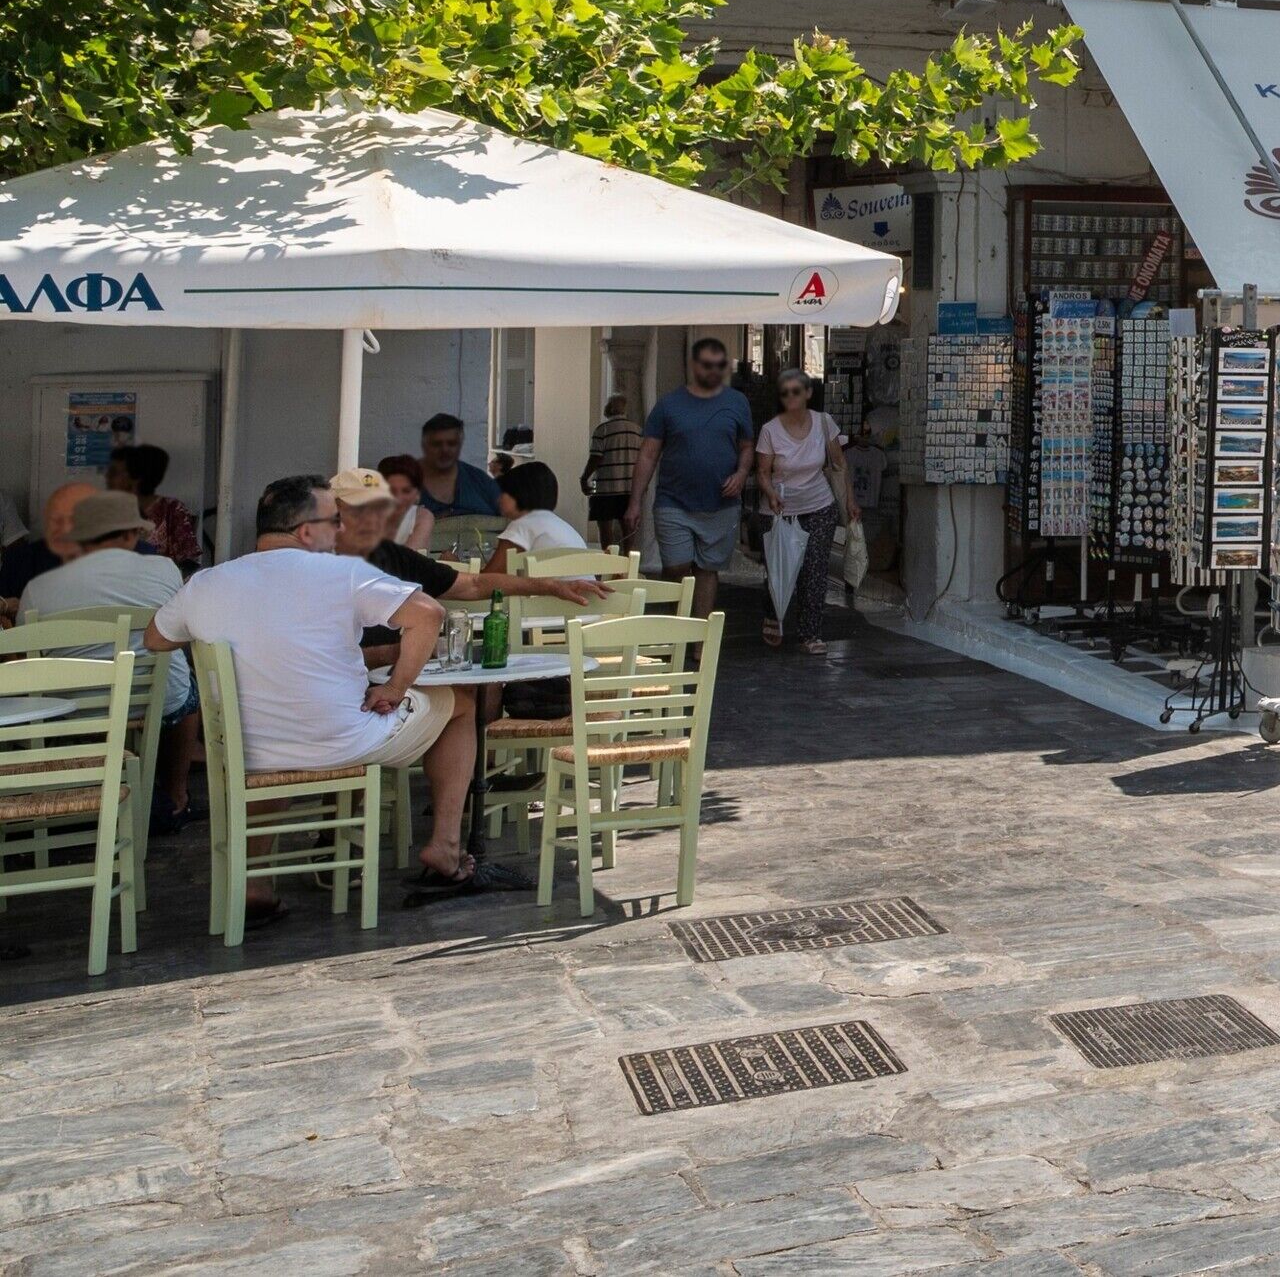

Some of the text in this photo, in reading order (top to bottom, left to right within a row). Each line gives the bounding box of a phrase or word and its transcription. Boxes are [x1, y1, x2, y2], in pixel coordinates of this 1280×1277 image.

[1136, 235, 1171, 286] ΟΝΟΜΑΤΑ
[0, 272, 165, 313] ΑΛΦΑ
[1053, 292, 1088, 300] ANDROS
